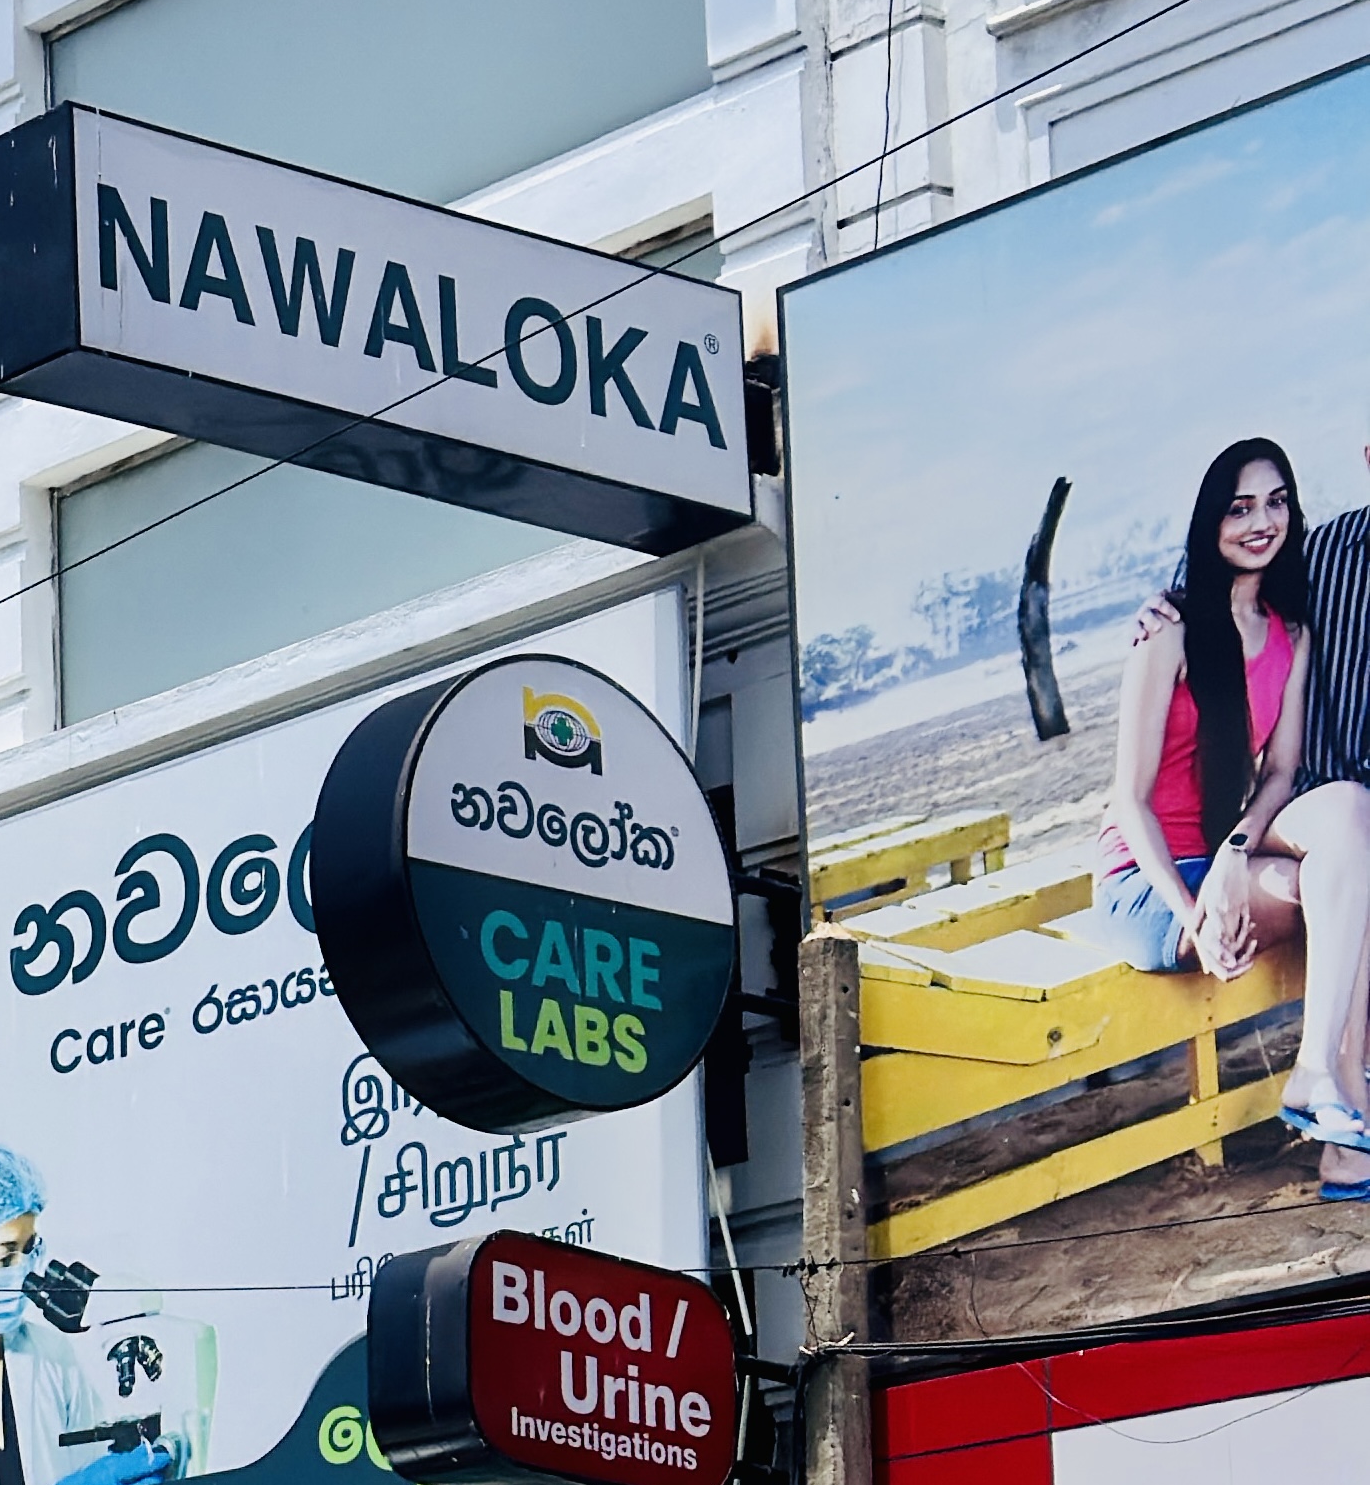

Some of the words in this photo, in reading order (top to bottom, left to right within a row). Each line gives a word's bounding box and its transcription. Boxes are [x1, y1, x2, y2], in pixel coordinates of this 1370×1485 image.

[96, 182, 728, 450] NAWALOKA
[450, 780, 675, 870] නවලෝක
[480, 909, 662, 1012] CARE
[50, 1012, 166, 1074] Care
[498, 989, 648, 1074] LABS
[492, 1260, 652, 1353] Blood
[560, 1350, 712, 1437] Urine
[511, 1406, 698, 1471] Investigations
